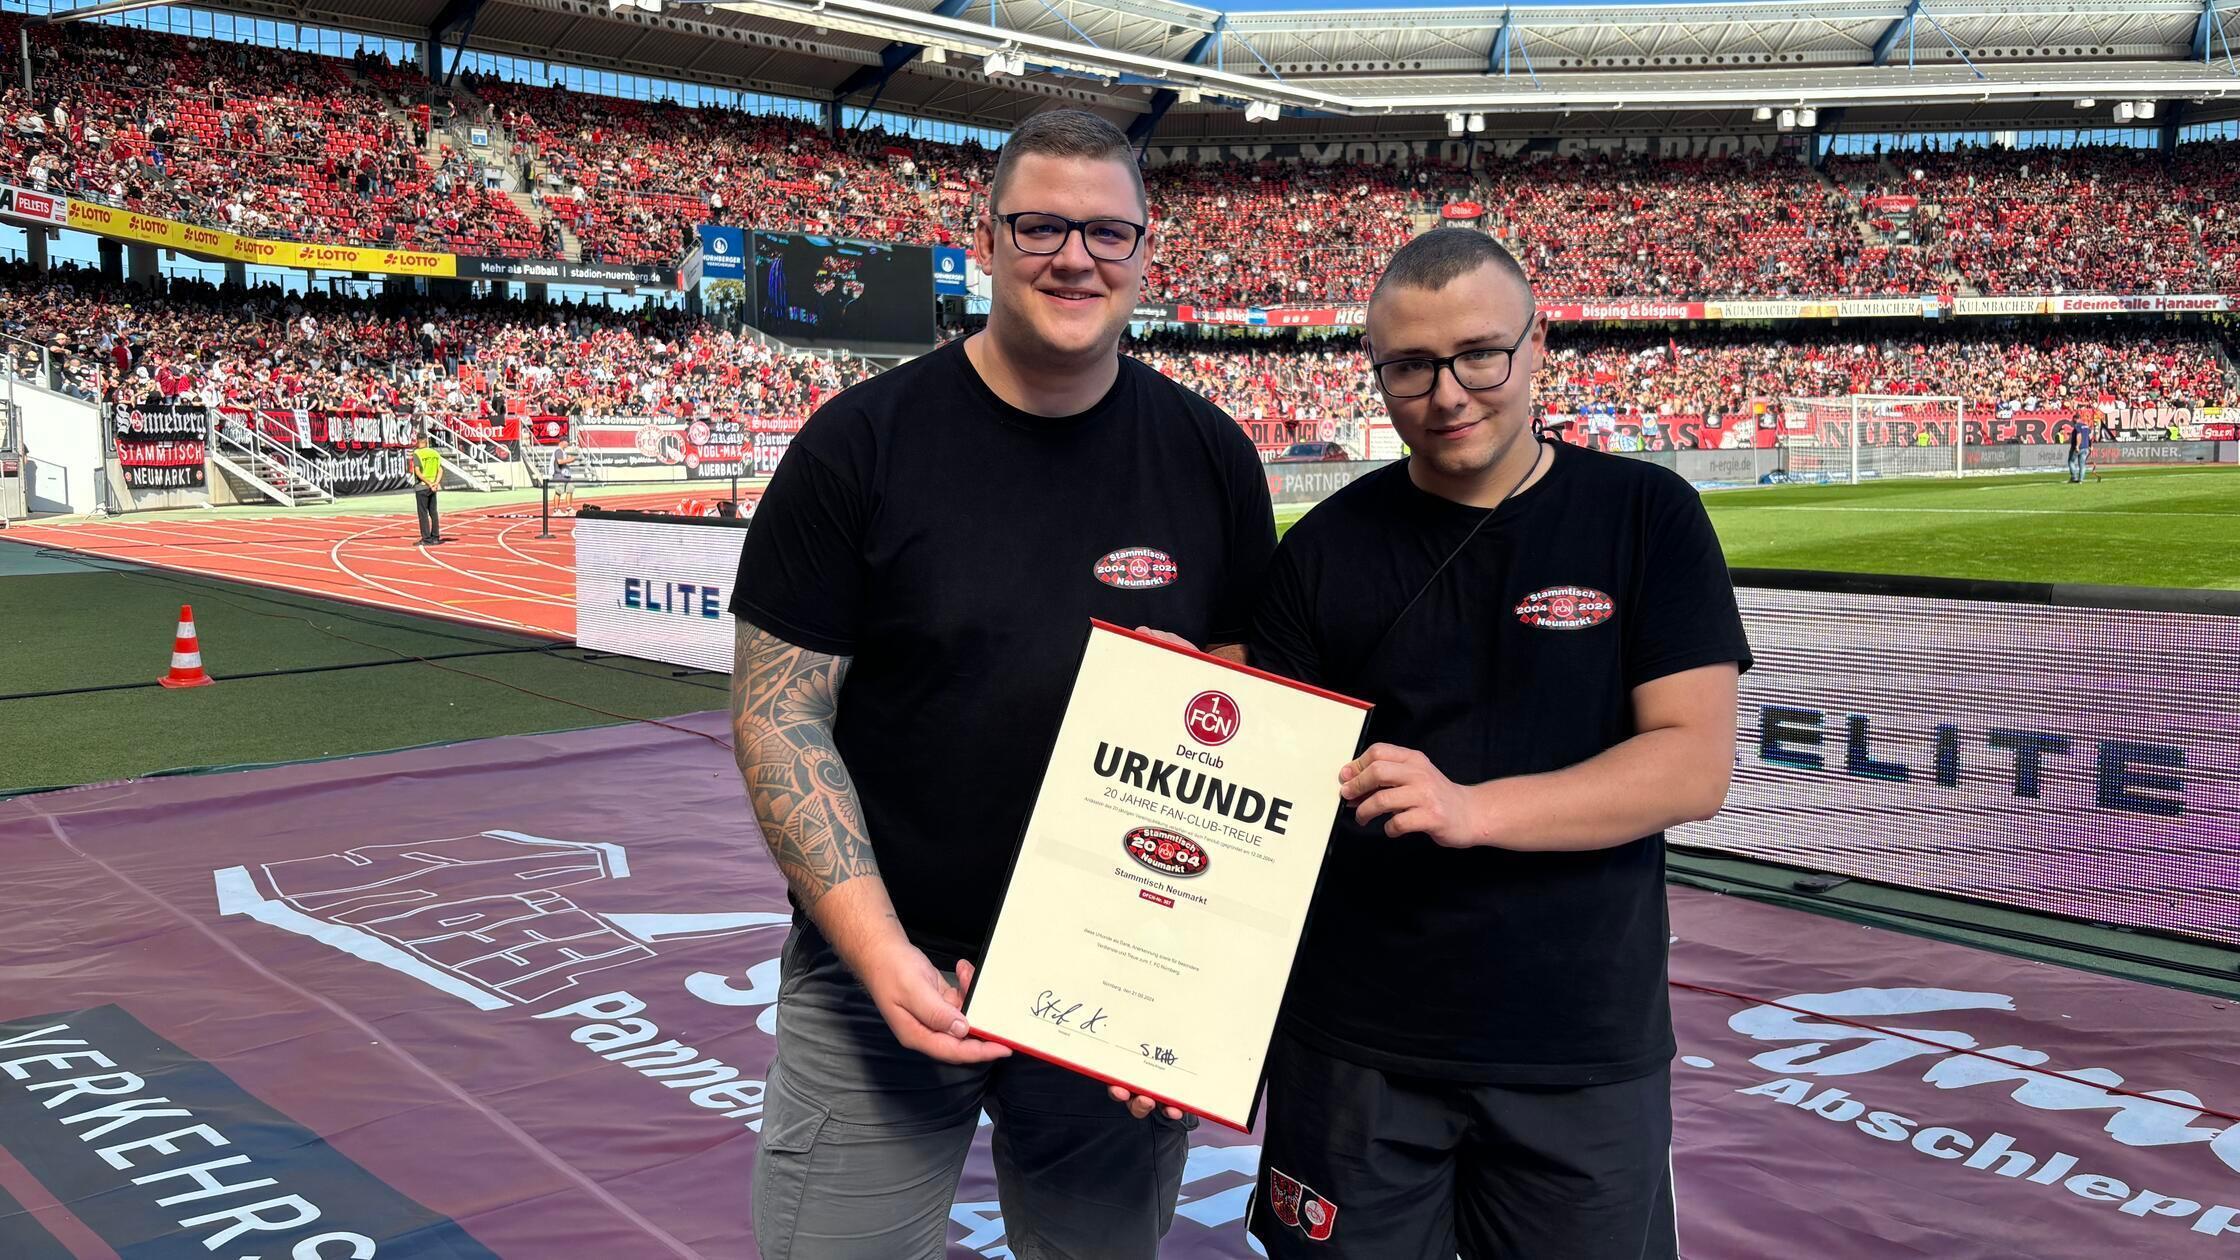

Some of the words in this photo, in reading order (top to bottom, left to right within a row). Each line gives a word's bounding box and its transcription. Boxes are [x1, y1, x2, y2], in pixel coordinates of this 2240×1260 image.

[18, 197, 50, 215] PELLETS
[82, 205, 111, 223] LOTTO
[140, 217, 168, 235] LOTTO
[194, 229, 219, 246] LOTTO
[244, 240, 275, 256] LOTTO
[317, 249, 357, 262] LOTTO
[400, 255, 438, 268] LOTTO
[481, 262, 506, 273] Mehr
[508, 264, 522, 274] als
[523, 264, 559, 276] Fußball
[570, 268, 661, 283] stadion-nuernberg.de
[1582, 304, 1628, 319] bisping
[1629, 305, 1640, 316] &
[1641, 304, 1687, 319] bisping
[1725, 303, 1798, 317] KULMBACHER
[1840, 302, 1915, 315] KULMBACHER
[1958, 300, 2034, 314] KULMBACHER
[2063, 298, 2150, 311] Edelmetalle
[2155, 297, 2219, 309] Hanauer
[583, 415, 651, 425] Rot-Schwarze
[654, 415, 677, 425] Hilfe
[2106, 406, 2192, 430] FIASKO
[1252, 423, 1269, 444] DI
[119, 441, 203, 461] STAMMTISCH
[697, 445, 742, 458] VOGL-MAX
[2122, 446, 2182, 458] PARTNER.
[698, 463, 744, 477] AUERBACH
[1709, 458, 1752, 473] n-ergie.de
[133, 467, 191, 486] NEUMARKT
[1109, 549, 1166, 561] Stammtisch
[1097, 565, 1126, 573] 2004
[1152, 564, 1177, 572] 2024
[1116, 576, 1164, 586] Neumarkt
[625, 577, 720, 619] ELITE
[1530, 588, 1596, 602] Stammtisch
[1516, 604, 1548, 615] 2004
[1578, 602, 1612, 611] 2024
[1536, 616, 1592, 627] Neumarkt
[1210, 696, 1221, 714] 1.
[1189, 707, 1232, 738] FCN
[1176, 744, 1198, 762] Der
[1198, 751, 1224, 769] Club
[1758, 704, 2187, 817] ELITE
[1093, 741, 1293, 835] URKUNDE
[1104, 786, 1118, 799] 20
[1120, 789, 1158, 813] JAHRE
[1160, 804, 1263, 847] FAN-CLUB-TREUE
[1144, 829, 1196, 852] Stammtisch
[1131, 836, 1156, 852] 20
[1176, 851, 1200, 867] 04
[1140, 852, 1185, 873] Neumarkt
[1114, 867, 1164, 890] Stammtisch
[1166, 884, 1208, 905] Neumarkt
